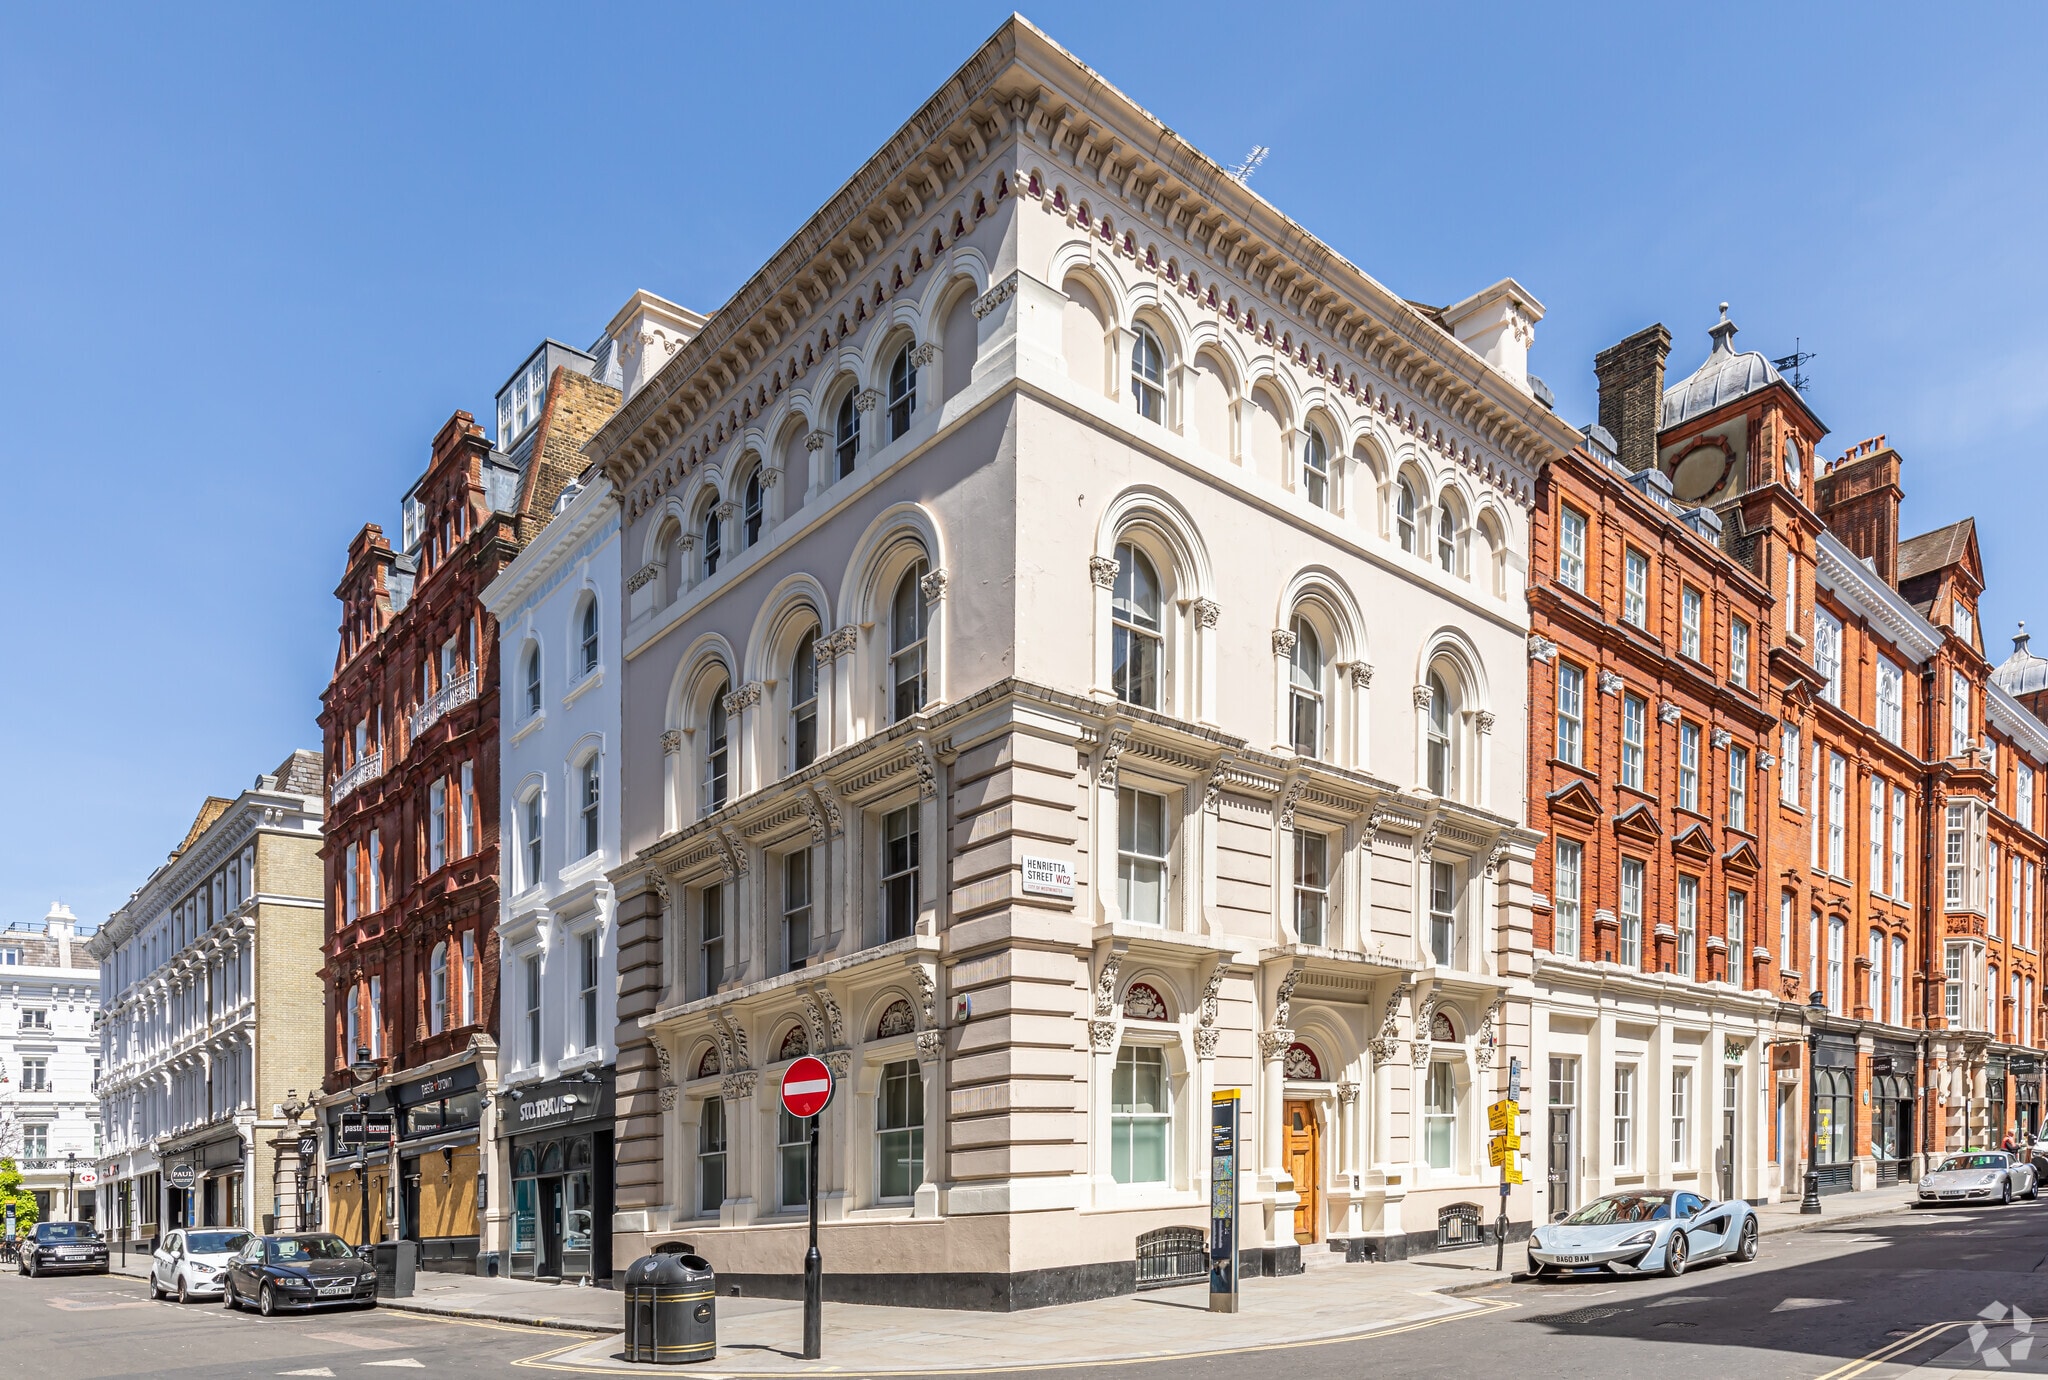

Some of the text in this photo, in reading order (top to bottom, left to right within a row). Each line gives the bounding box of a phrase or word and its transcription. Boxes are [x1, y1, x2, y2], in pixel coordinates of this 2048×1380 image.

[1027, 859, 1066, 873] HENRIETTA
[1027, 870, 1071, 885] STREET WC2
[368, 1122, 389, 1131] brown
[1556, 1255, 1590, 1263] BA60 BAM
